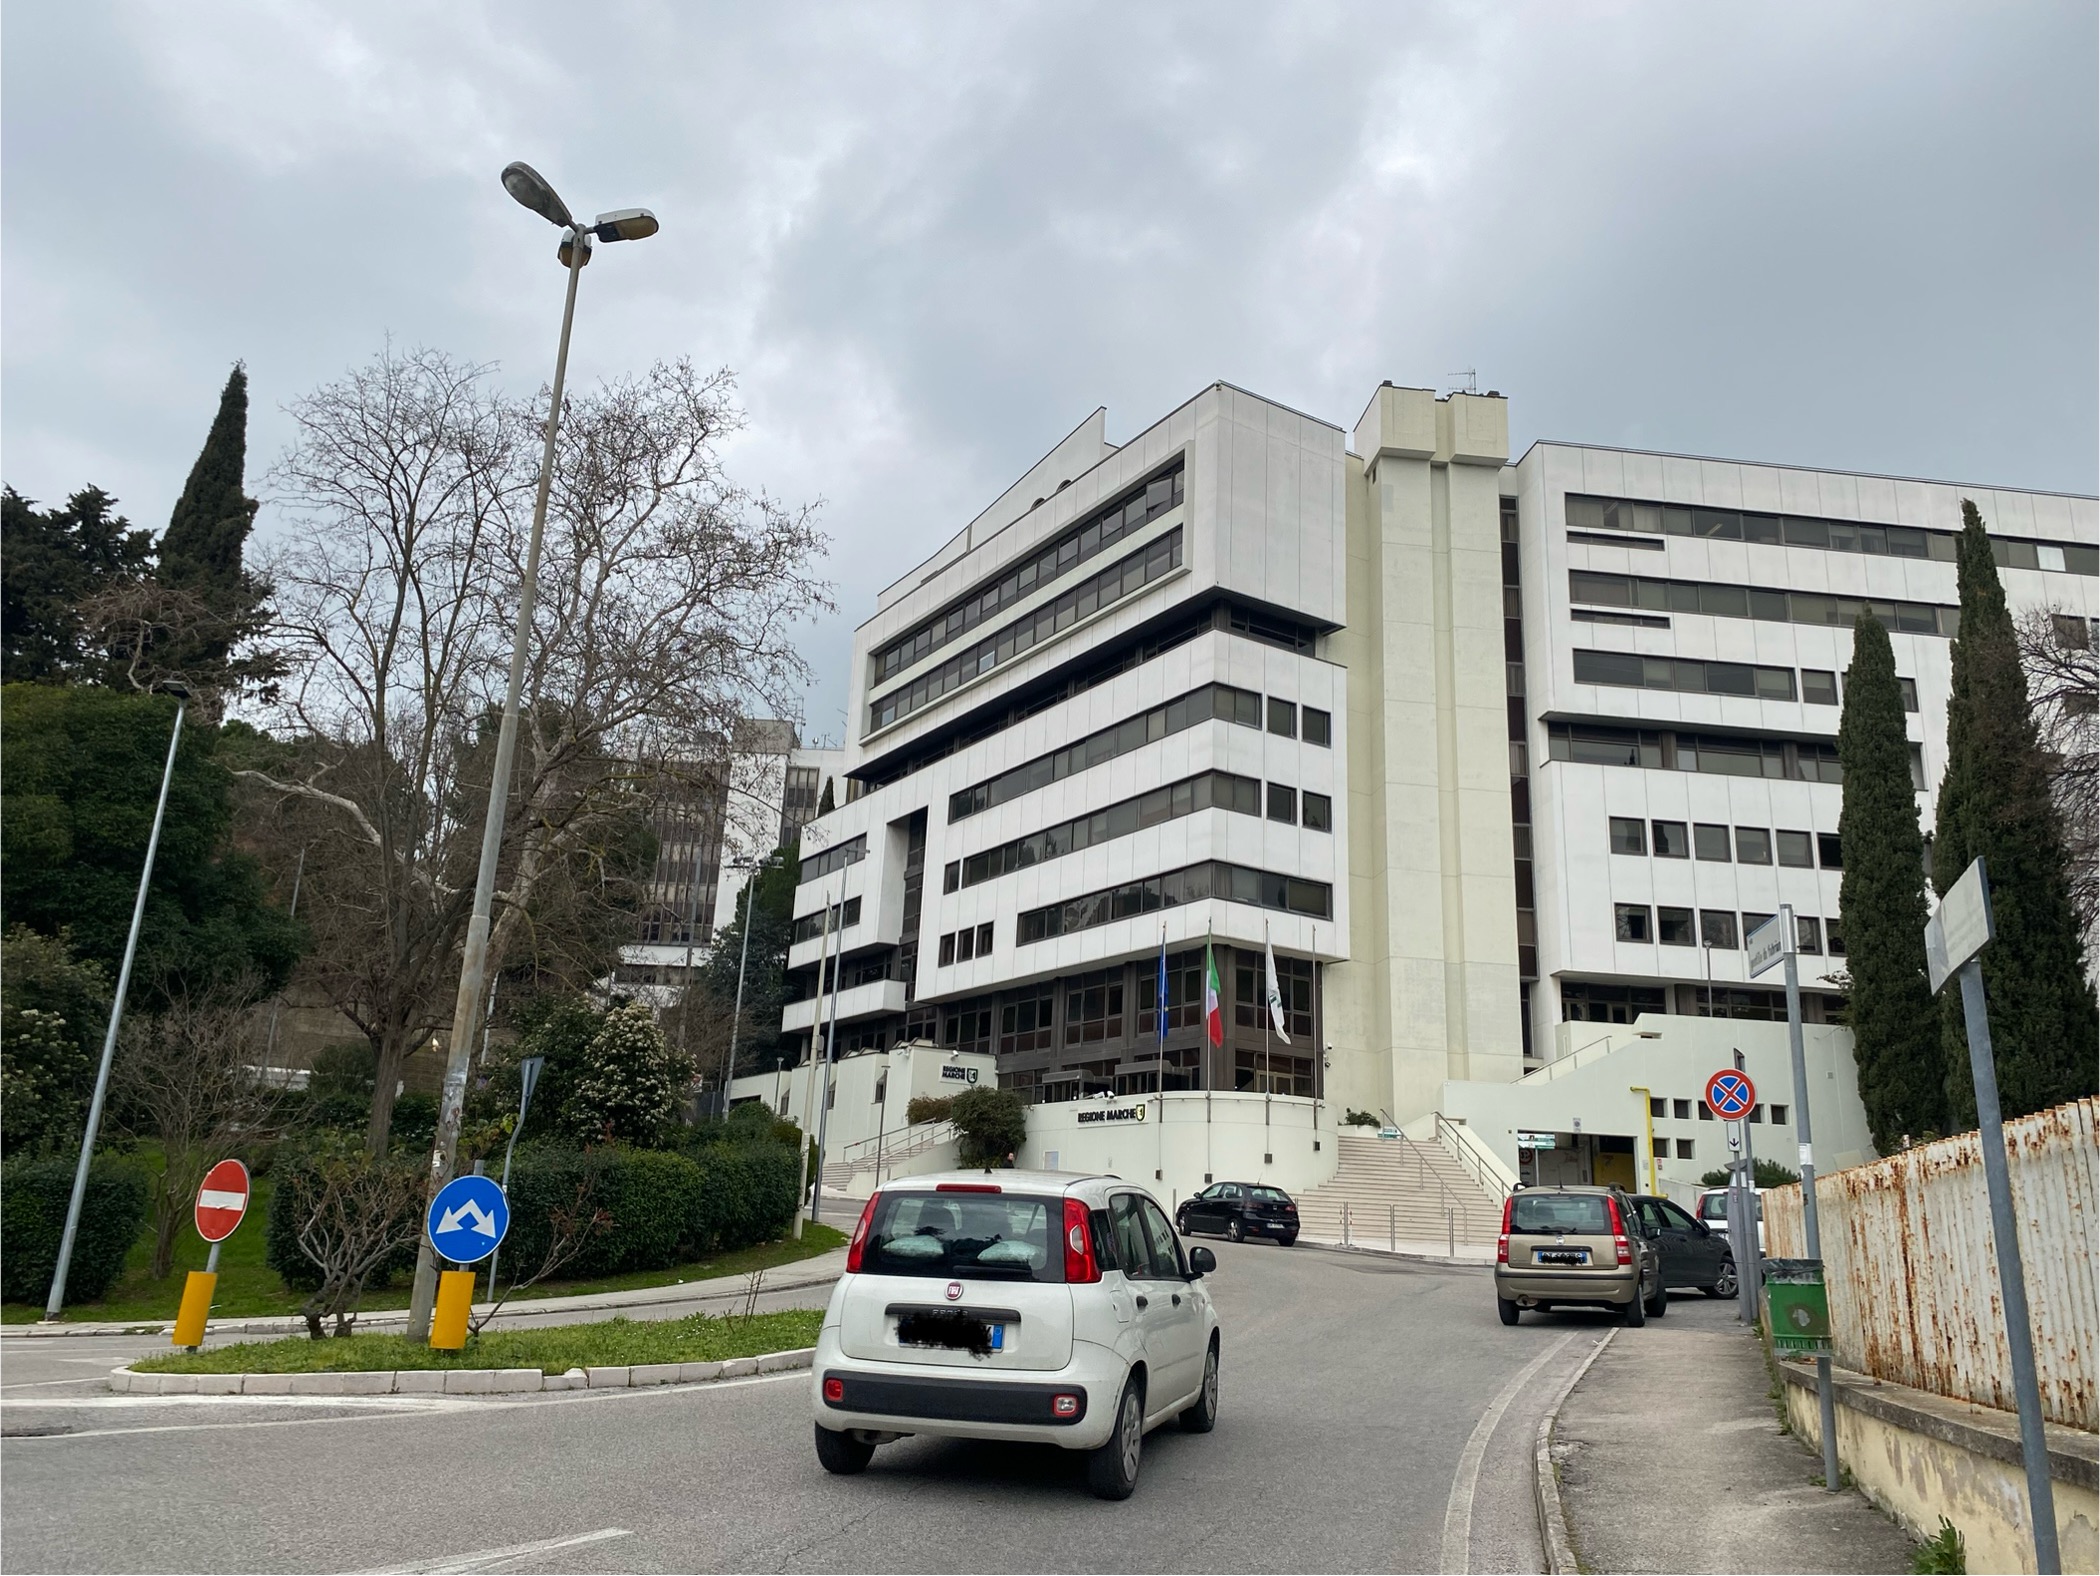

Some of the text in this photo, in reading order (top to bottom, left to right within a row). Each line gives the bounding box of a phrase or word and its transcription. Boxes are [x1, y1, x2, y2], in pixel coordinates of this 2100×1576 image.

[942, 1072, 965, 1080] MARCHE
[1078, 1108, 1136, 1122] REGIONE MARCHE
